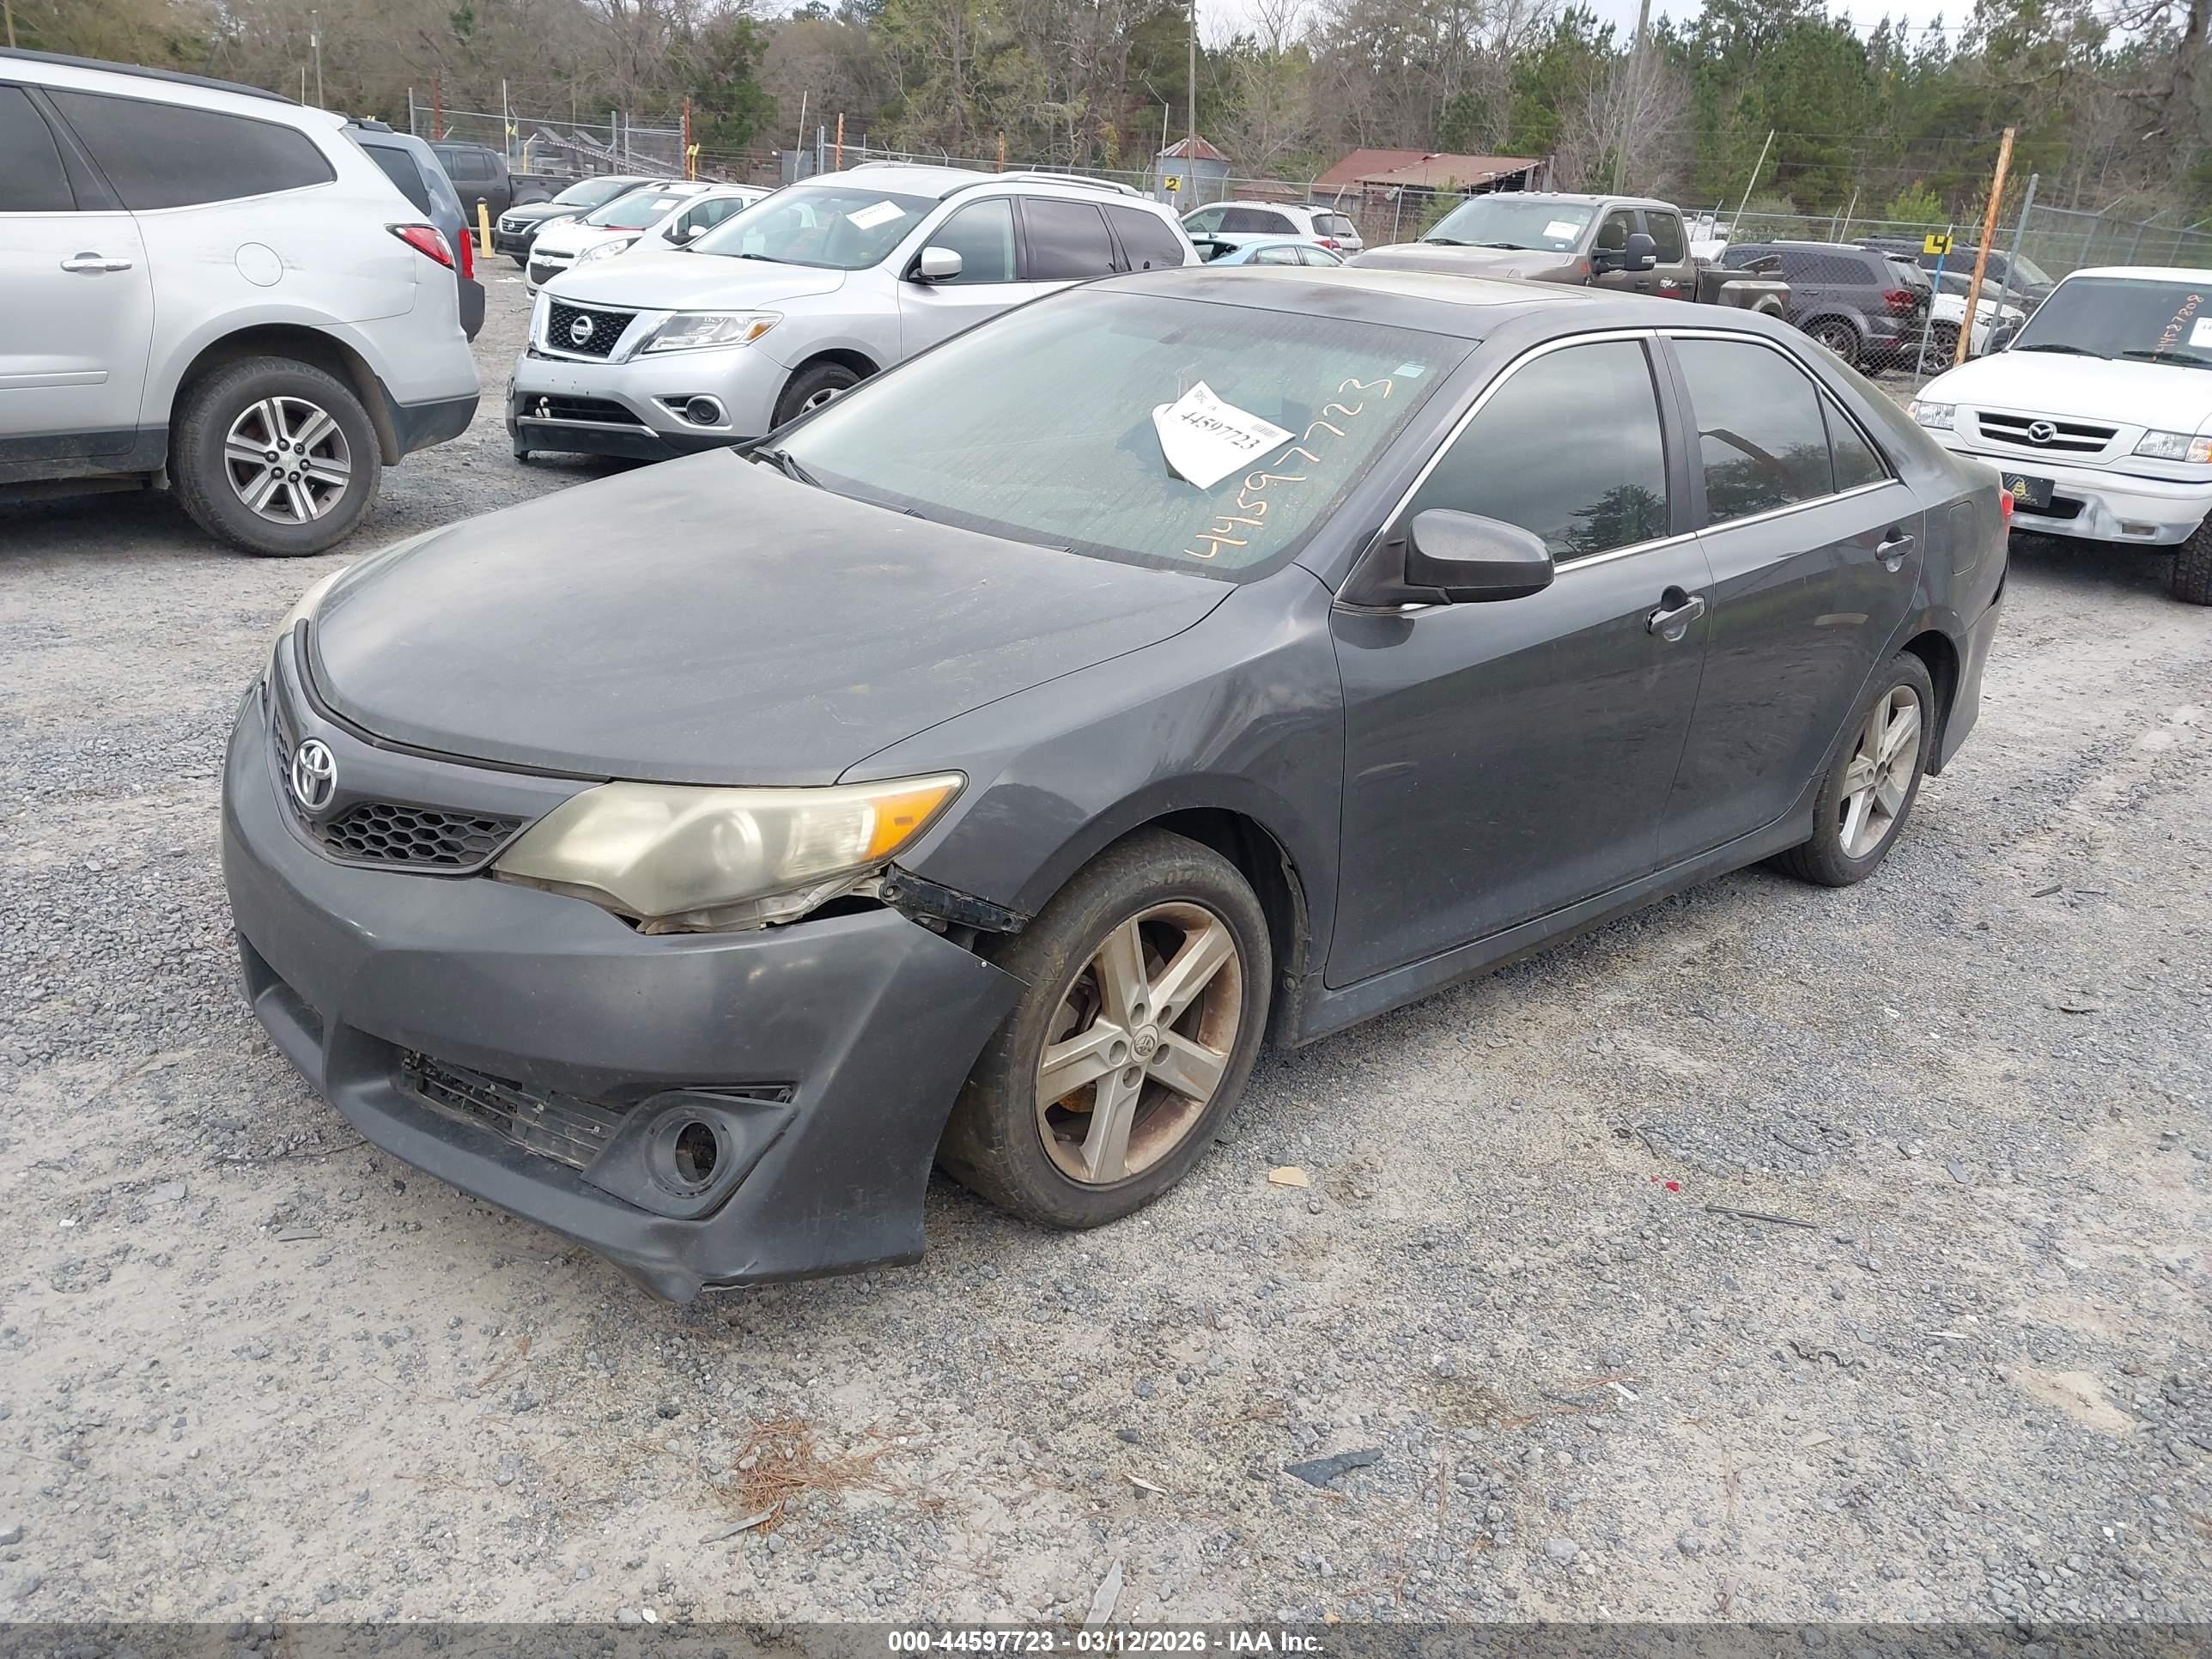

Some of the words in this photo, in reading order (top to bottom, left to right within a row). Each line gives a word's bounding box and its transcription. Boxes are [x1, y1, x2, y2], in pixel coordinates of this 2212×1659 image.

[1166, 177, 1176, 191] 2
[1932, 234, 1949, 254] 4
[1181, 411, 1261, 450] 44597723
[1183, 378, 1393, 558] 44597723
